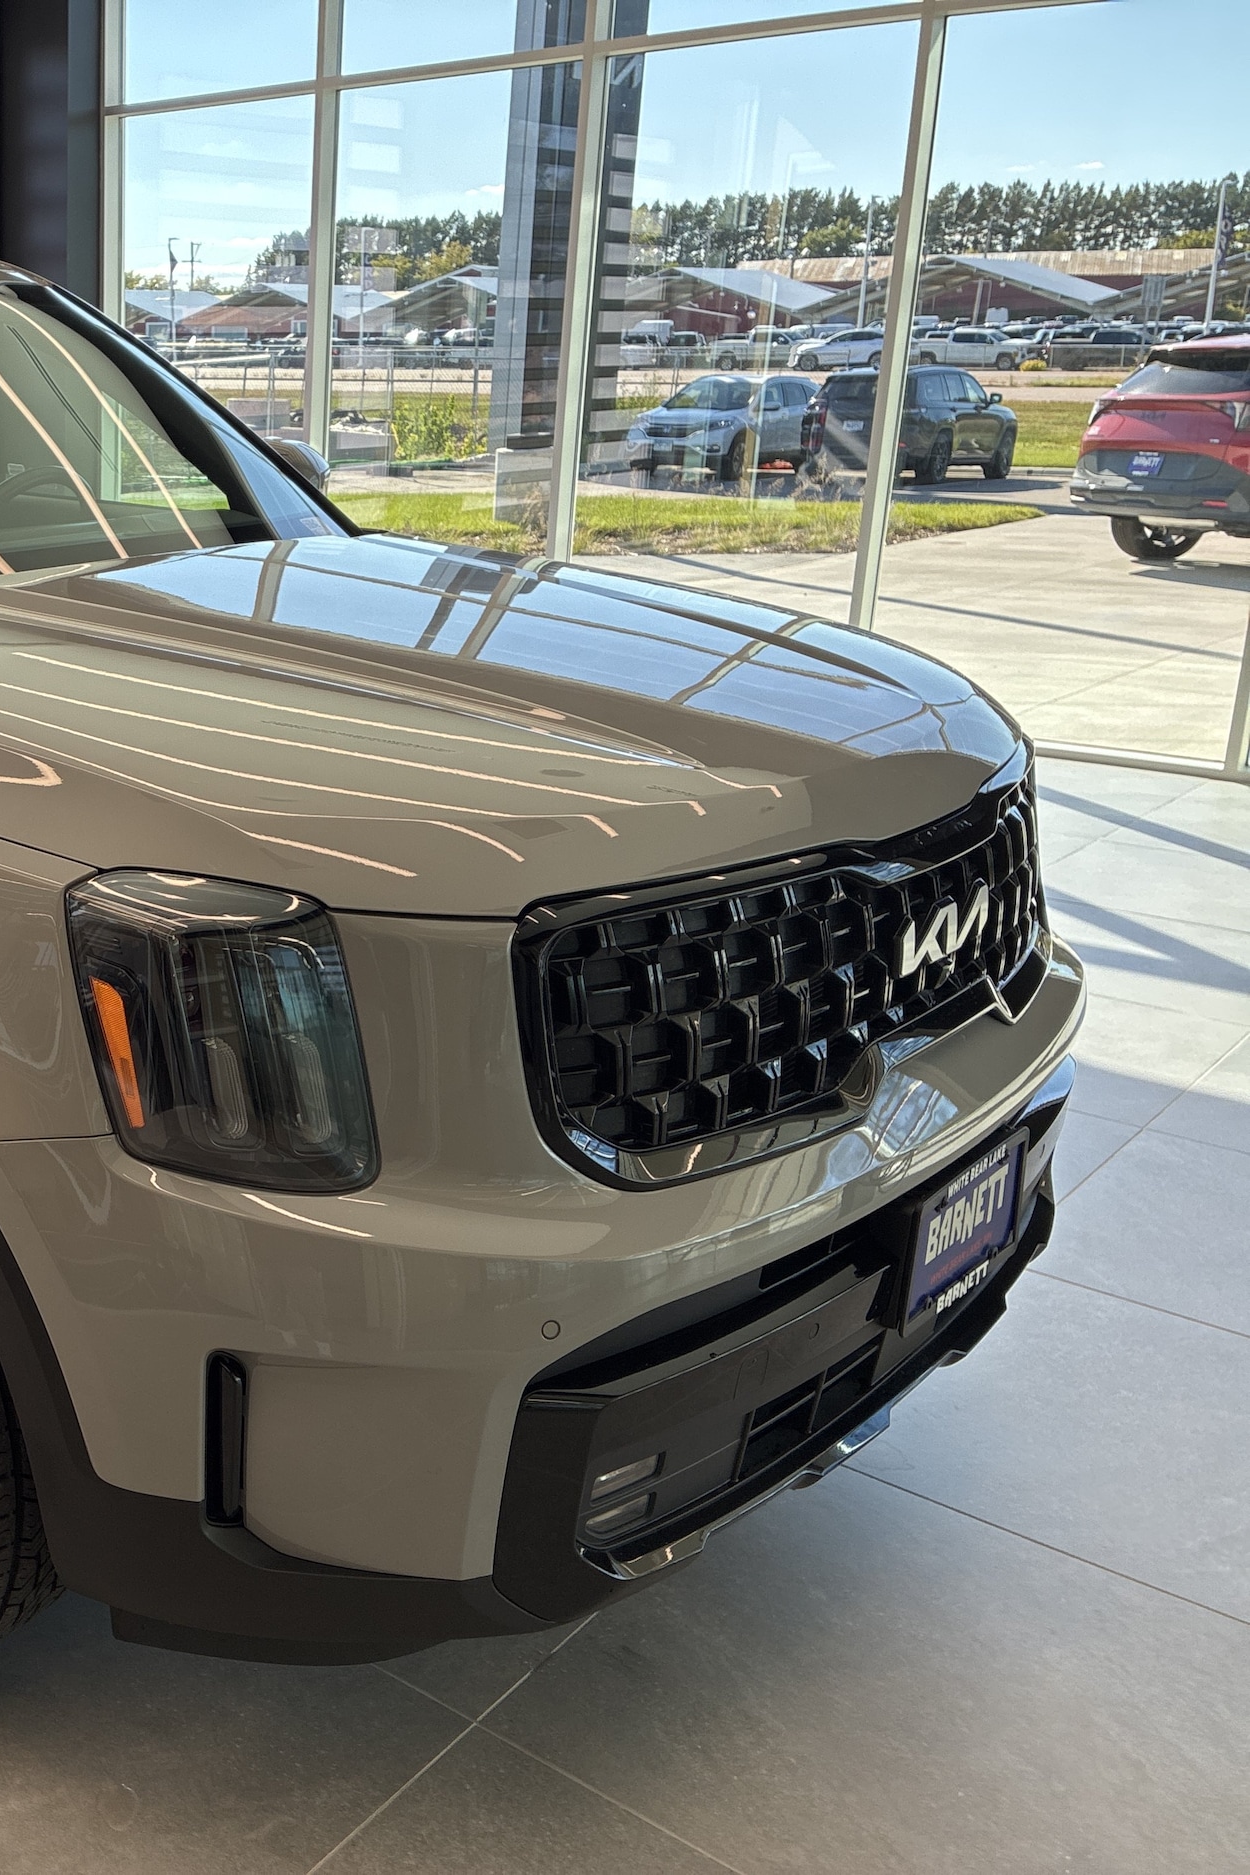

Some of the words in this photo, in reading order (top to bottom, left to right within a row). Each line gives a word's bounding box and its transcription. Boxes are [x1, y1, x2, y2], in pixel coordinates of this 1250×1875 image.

[947, 1170, 970, 1199] WHITE
[970, 1157, 989, 1183] BEAR
[988, 1143, 1007, 1168] LAKE
[924, 1163, 1009, 1266] BARNETT
[936, 1260, 990, 1315] BARNETT
